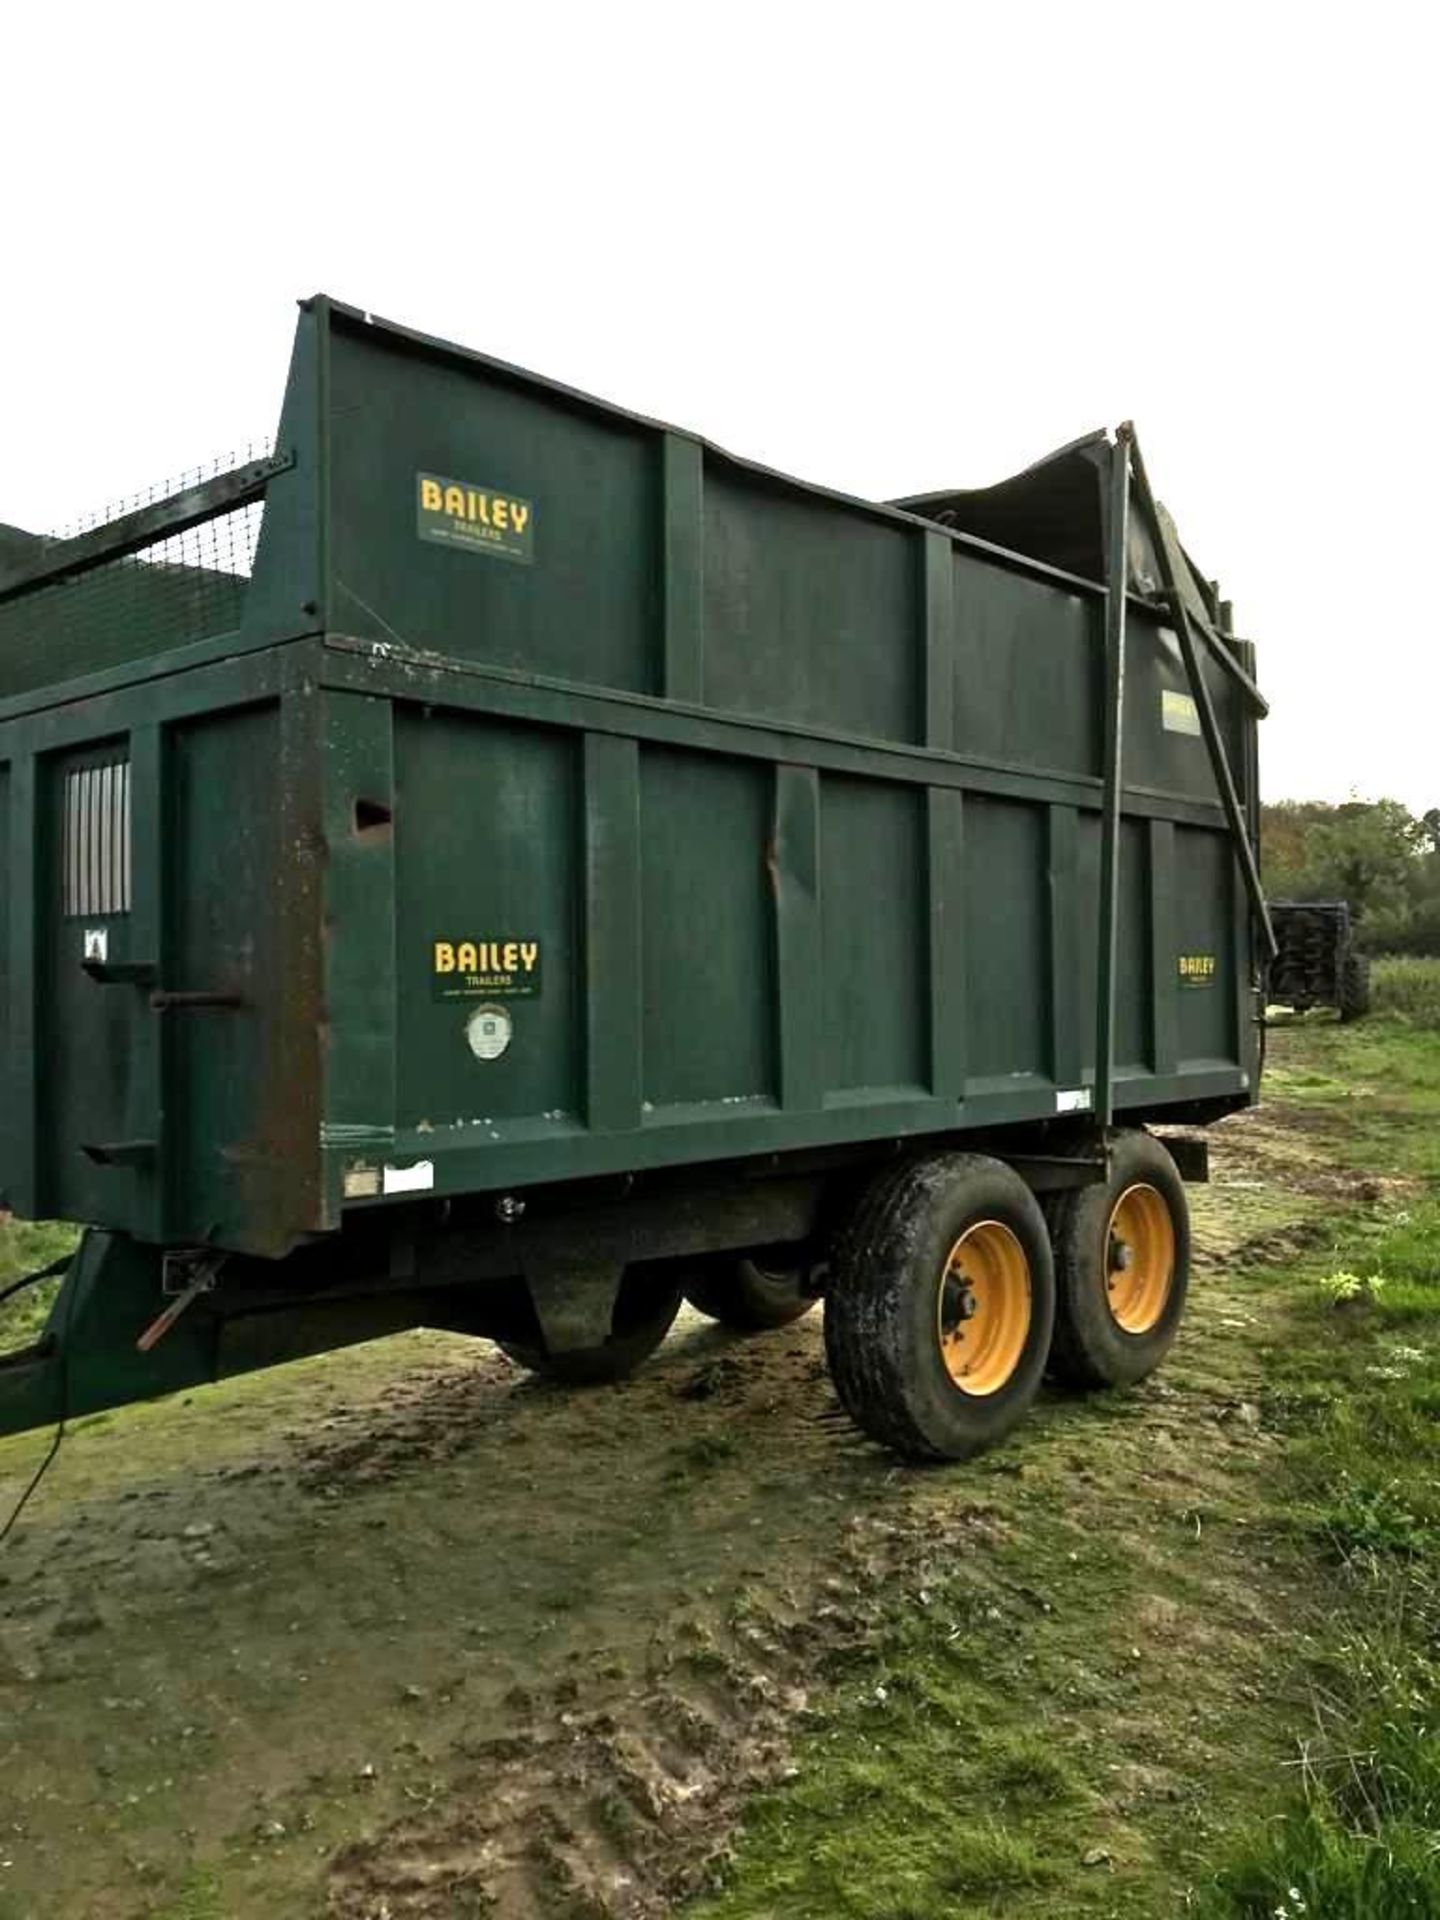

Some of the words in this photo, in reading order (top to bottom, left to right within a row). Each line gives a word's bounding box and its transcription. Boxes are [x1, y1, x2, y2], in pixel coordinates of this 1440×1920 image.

[421, 479, 528, 534] BAILEY
[435, 942, 537, 973] BAILEY
[465, 975, 512, 987] TRAILERS
